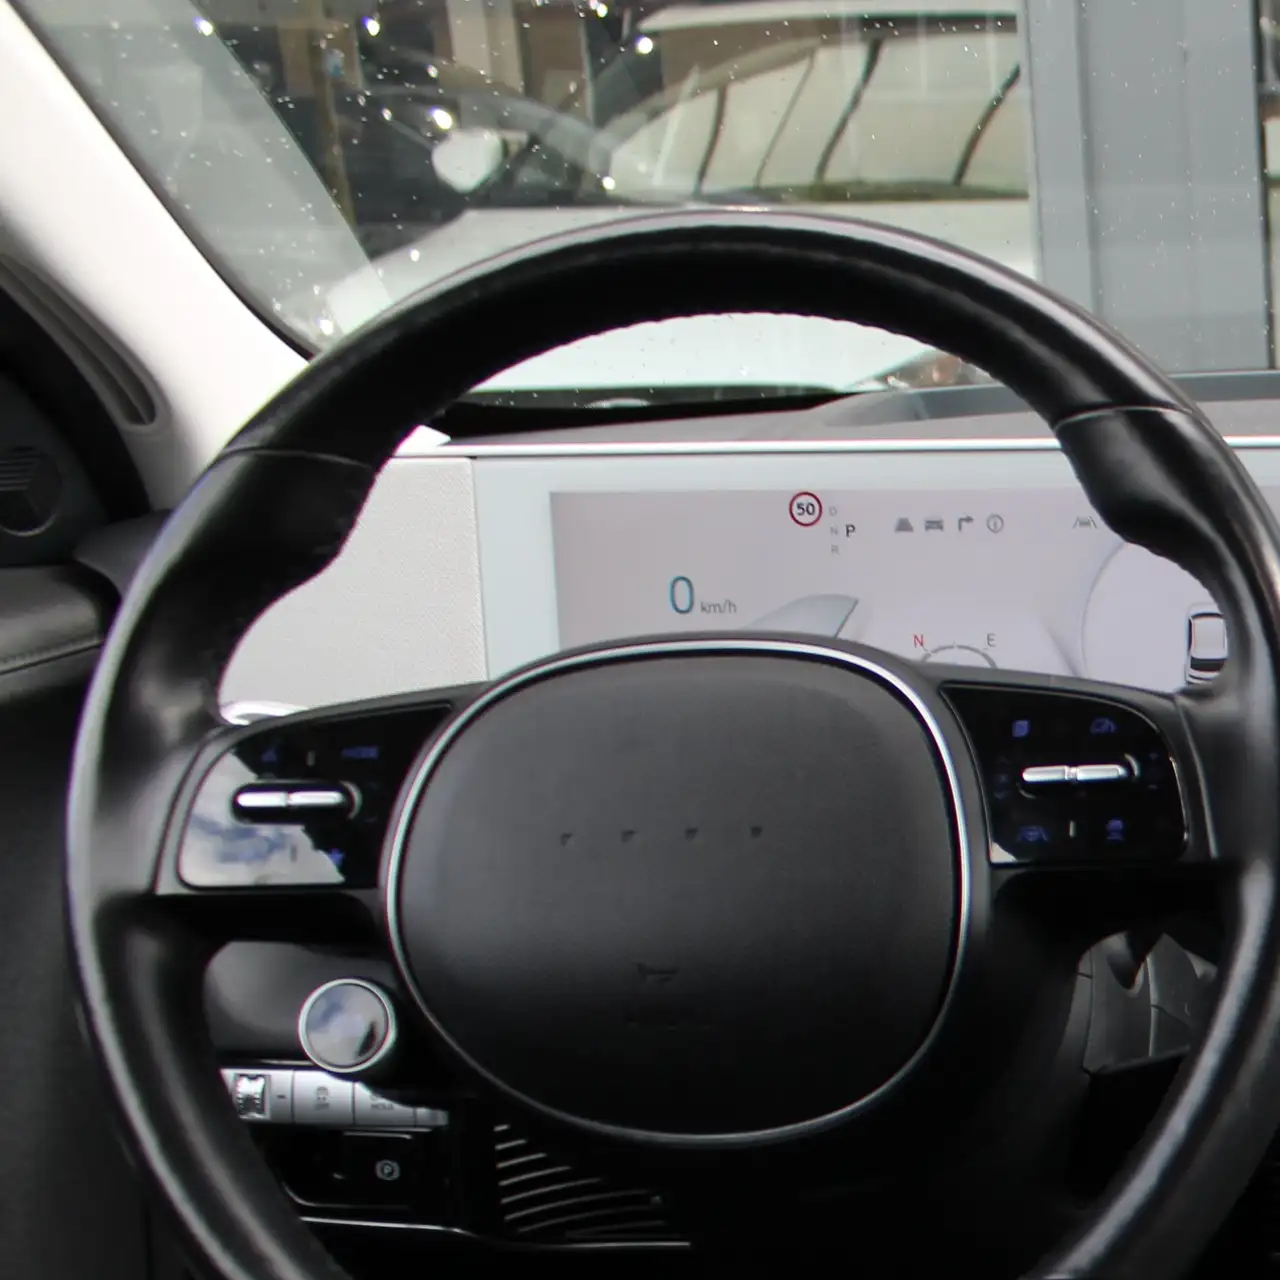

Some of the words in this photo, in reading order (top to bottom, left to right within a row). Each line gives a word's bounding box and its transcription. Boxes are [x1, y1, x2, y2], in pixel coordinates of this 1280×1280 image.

[796, 501, 816, 518] 50
[846, 524, 856, 538] P
[669, 575, 695, 615] 0
[700, 599, 737, 615] km/h
[914, 635, 924, 648] N
[987, 634, 995, 647] E
